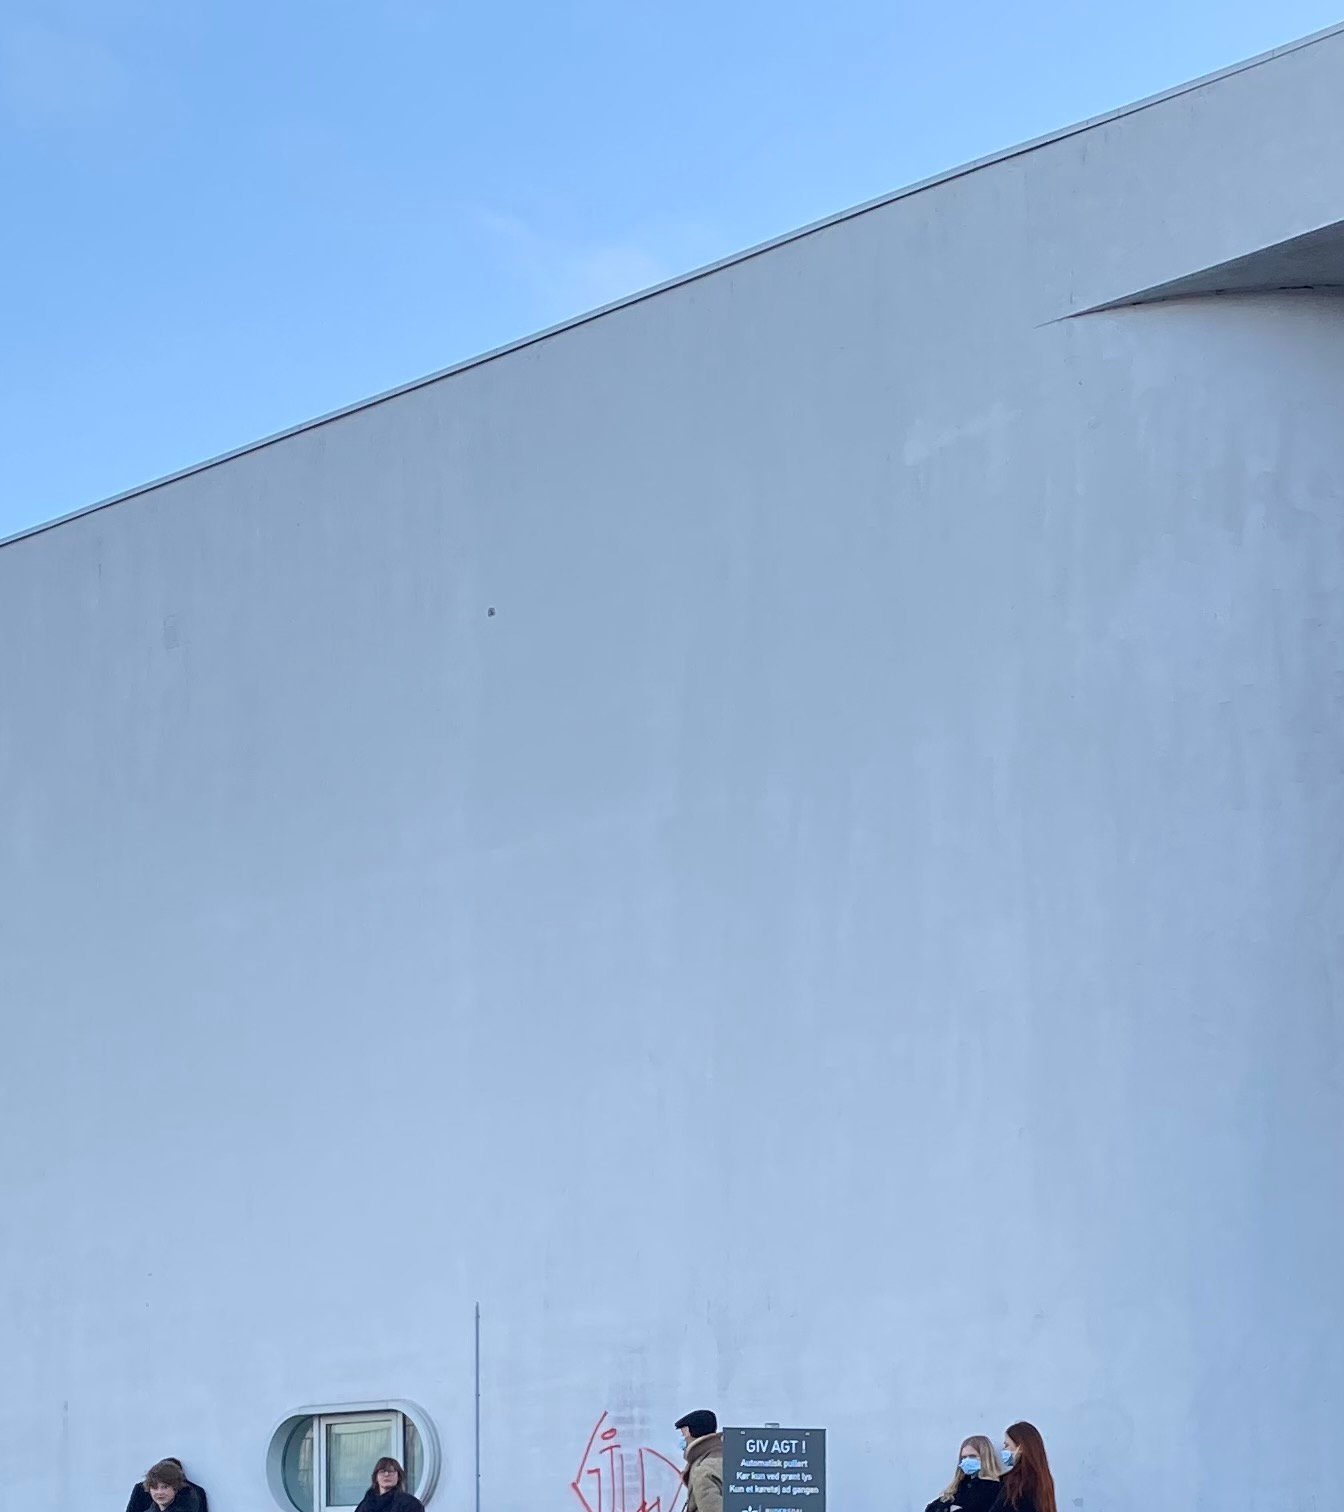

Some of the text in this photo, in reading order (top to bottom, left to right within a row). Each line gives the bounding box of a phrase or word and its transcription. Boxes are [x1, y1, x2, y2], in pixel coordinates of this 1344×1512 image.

[746, 1439, 806, 1454] GIV AGT !
